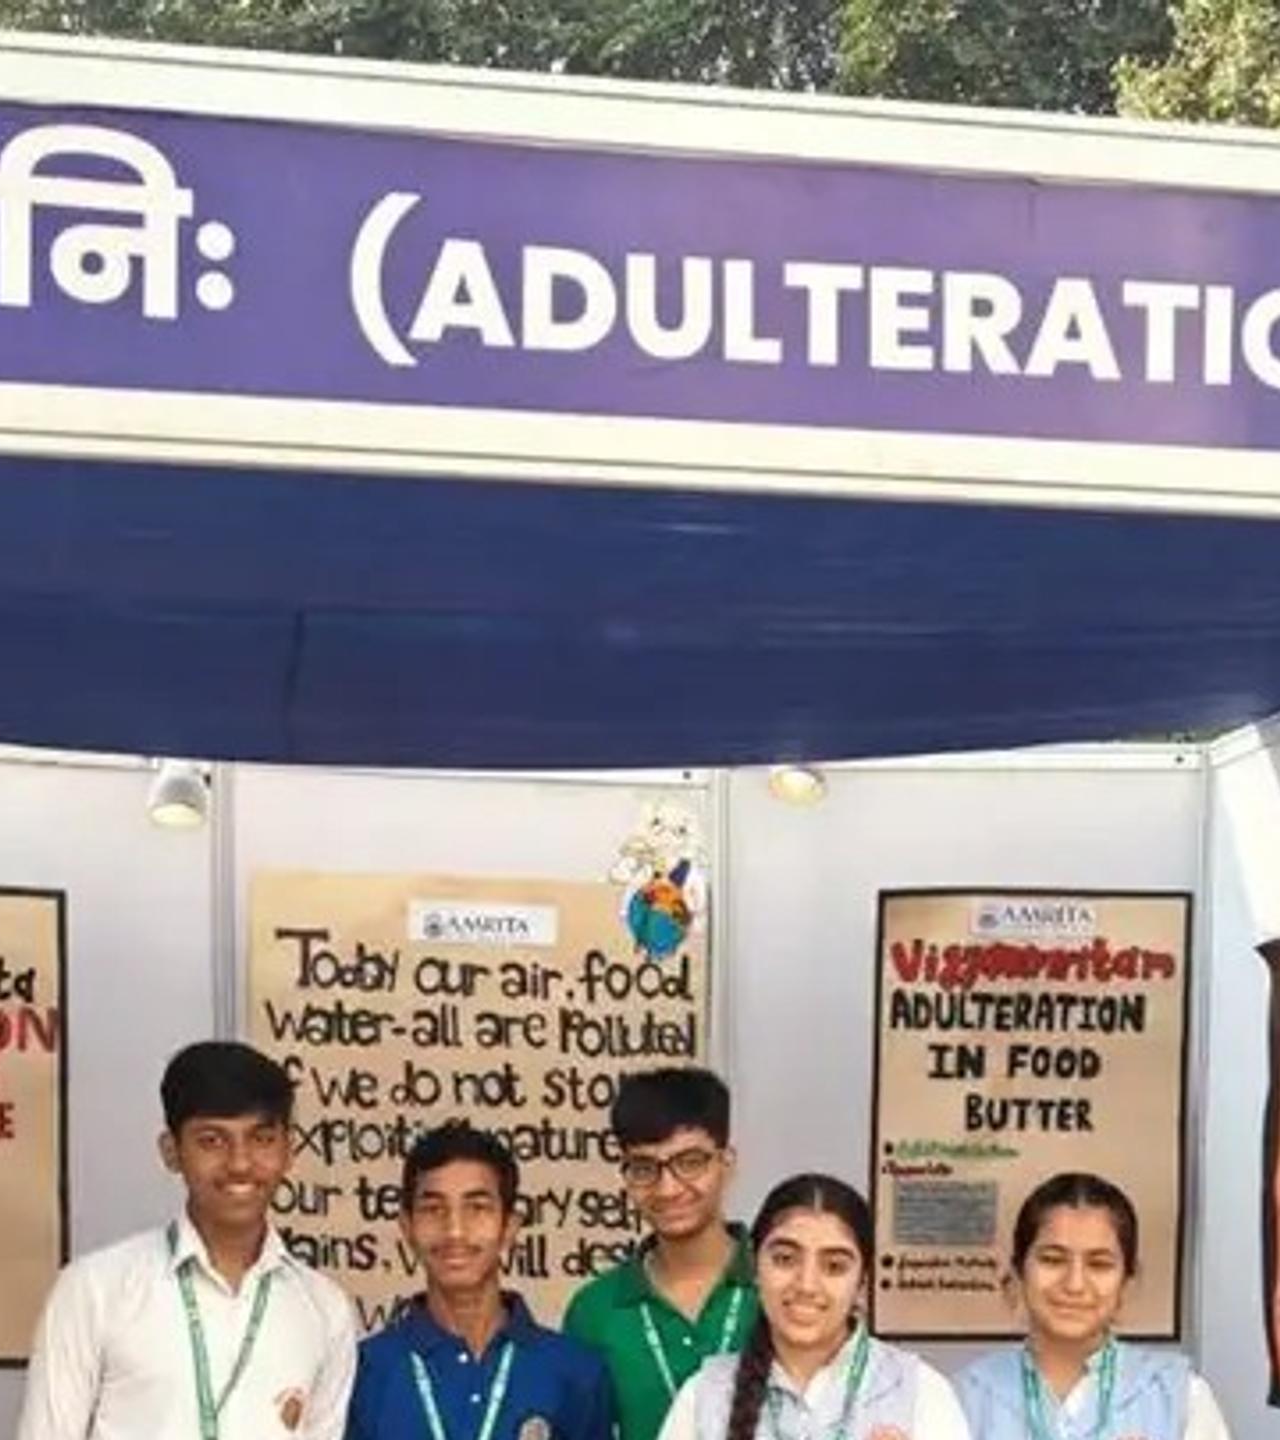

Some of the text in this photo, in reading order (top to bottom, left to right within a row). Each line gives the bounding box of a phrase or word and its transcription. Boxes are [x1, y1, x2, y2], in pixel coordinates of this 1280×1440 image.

[275, 928, 401, 993] Today
[413, 956, 488, 994] our
[474, 1010, 548, 1049] are
[889, 988, 1147, 1034] ADULTERATION
[927, 1044, 1102, 1080] IN FOOD
[452, 1062, 528, 1108] not
[542, 1066, 616, 1112] sto
[965, 1091, 1095, 1133] BUTTER
